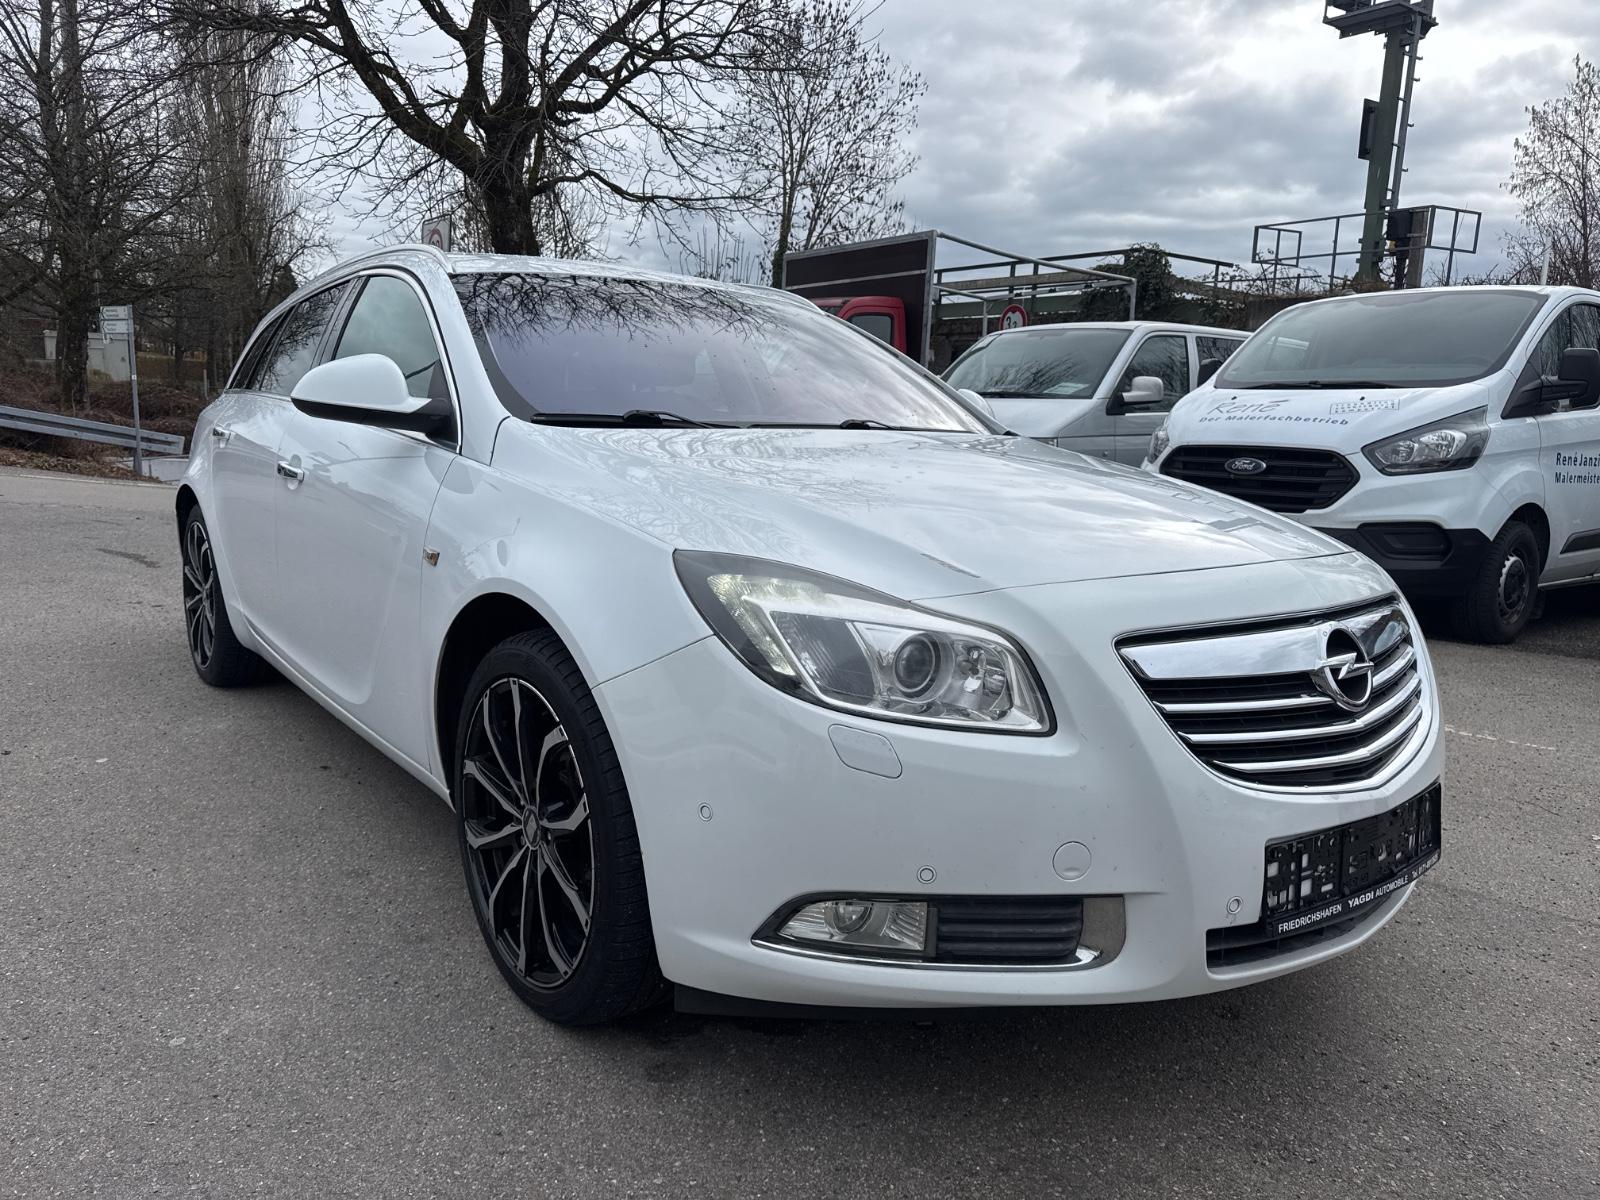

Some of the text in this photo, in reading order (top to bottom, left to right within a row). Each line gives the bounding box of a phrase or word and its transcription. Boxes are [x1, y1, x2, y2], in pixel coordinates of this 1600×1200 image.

[1225, 414, 1349, 426] Malerfachbetrieb
[1278, 903, 1342, 934] FRIEDRICHSHAFEN
[1348, 891, 1374, 908] YAGDI
[1375, 874, 1409, 897] AUTOMOBILE
